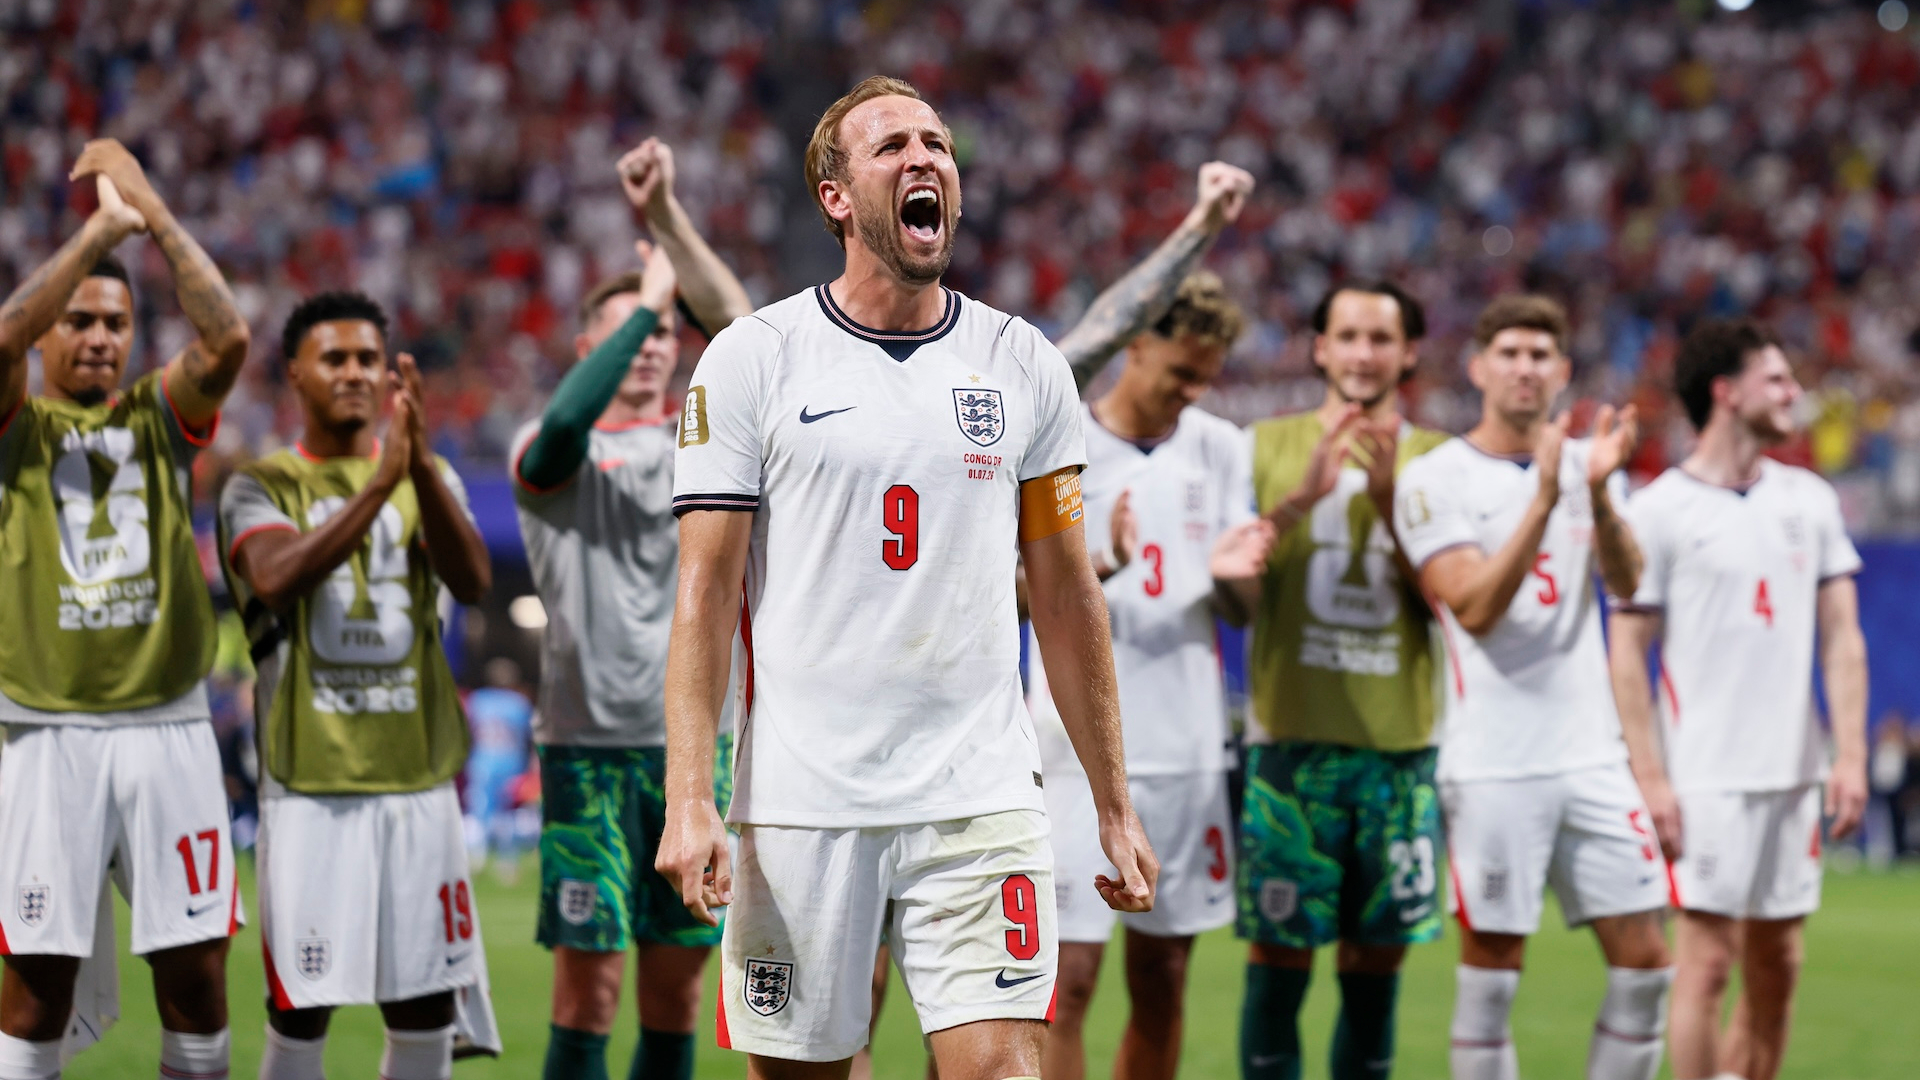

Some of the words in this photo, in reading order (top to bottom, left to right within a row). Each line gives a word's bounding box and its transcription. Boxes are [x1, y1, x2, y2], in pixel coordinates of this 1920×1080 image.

[964, 453, 992, 465] CONGO
[993, 456, 1002, 467] DR
[882, 484, 919, 571] 9
[83, 546, 128, 568] FIFA
[1143, 543, 1165, 597] 3
[1532, 552, 1560, 606] 5
[58, 582, 121, 605] WORLD
[122, 577, 156, 600] CUP
[58, 600, 161, 631] 2026
[1753, 577, 1774, 629] 4
[340, 629, 386, 648] FIFA
[311, 686, 418, 715] 2026
[177, 828, 219, 896] 17
[1204, 826, 1229, 882] 3
[1387, 836, 1435, 900] 23
[438, 879, 473, 944] 19
[1001, 873, 1040, 961] 9
